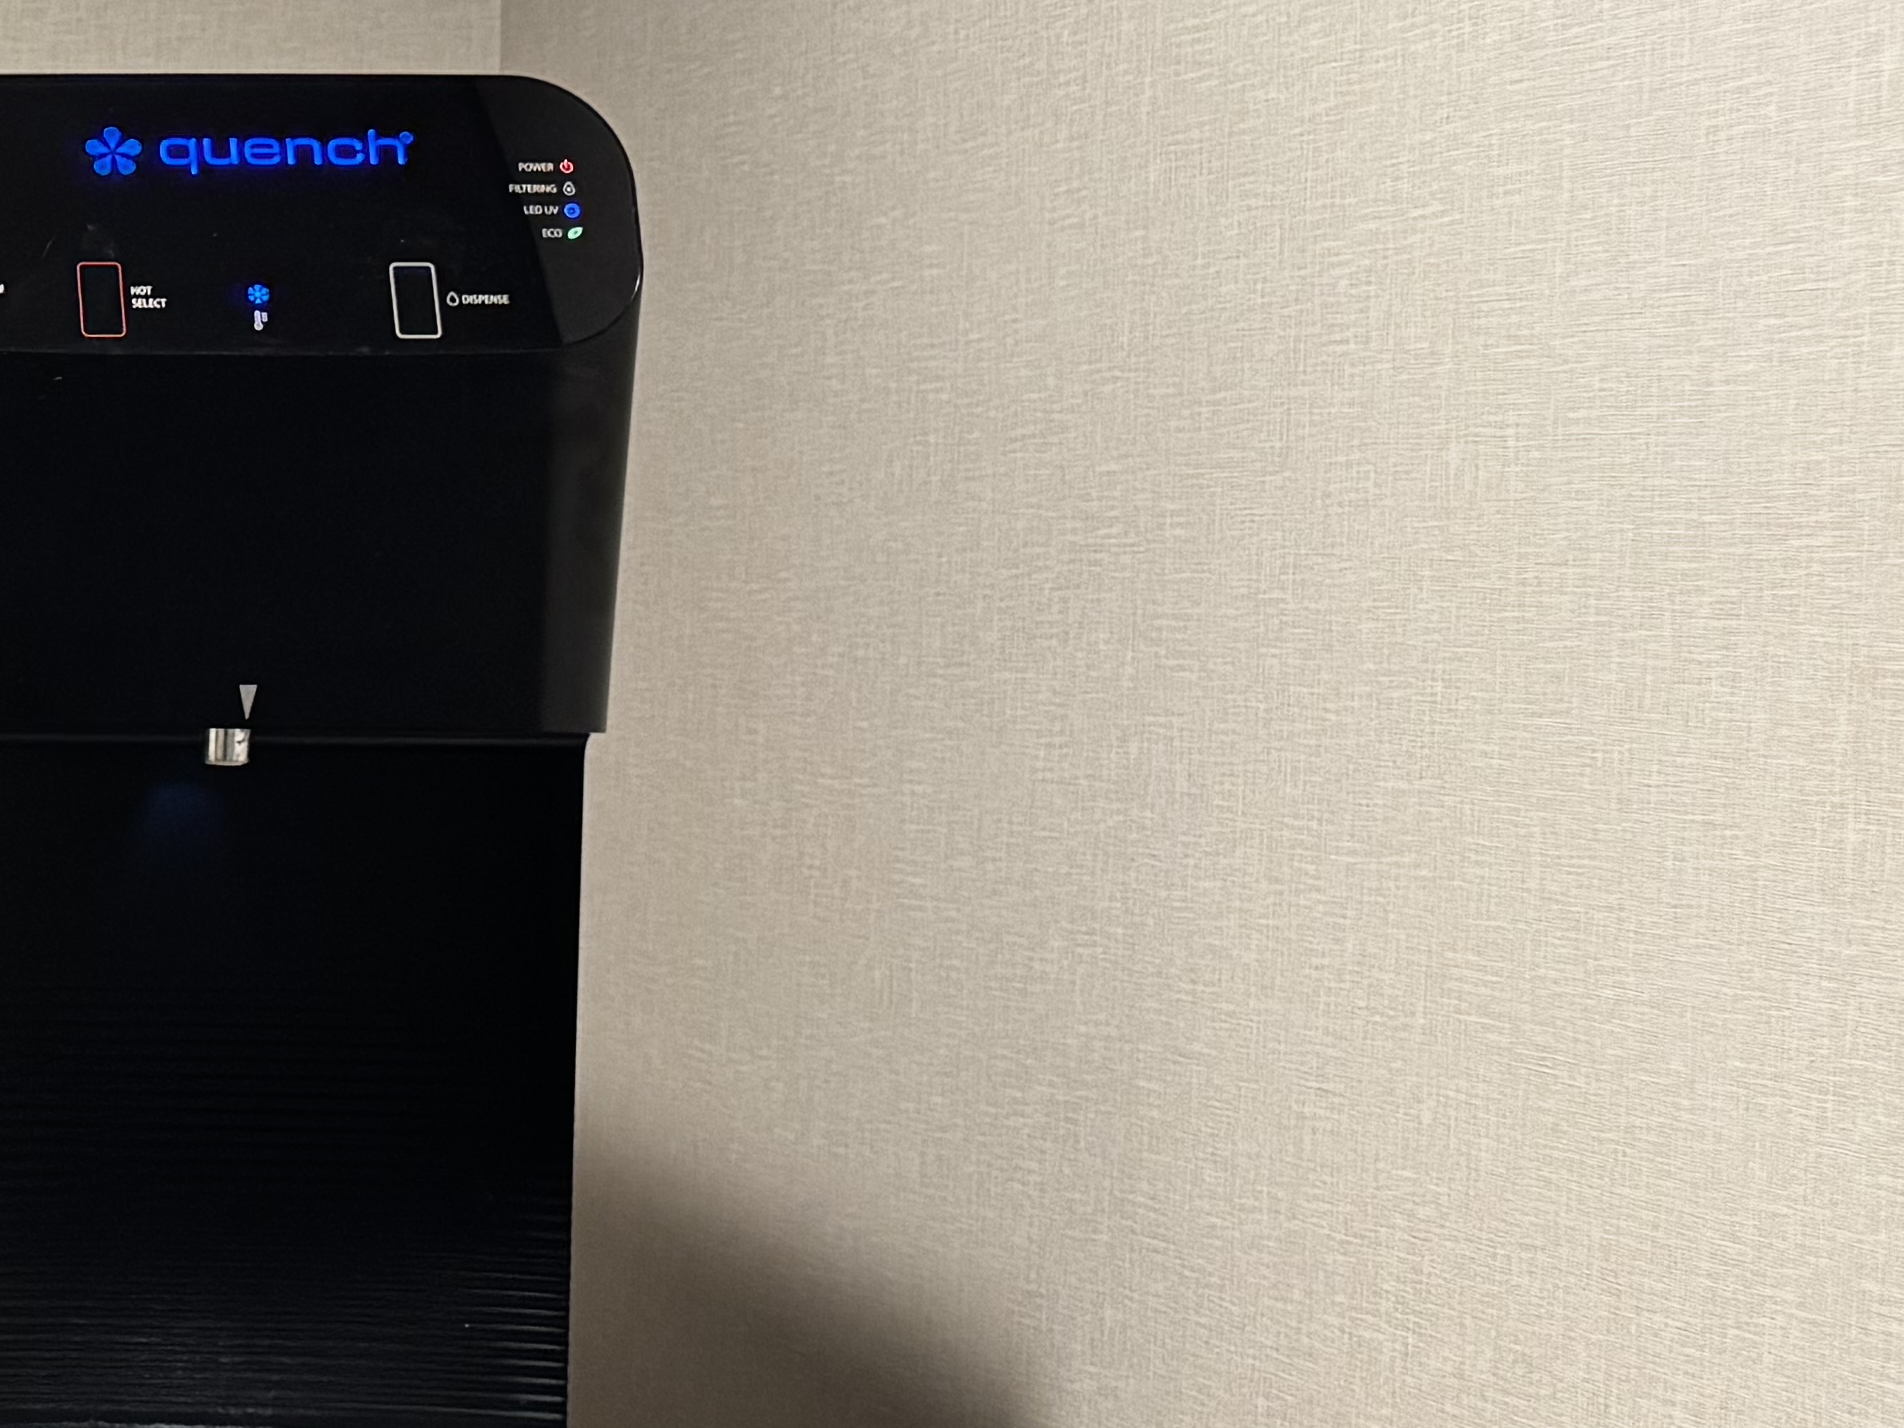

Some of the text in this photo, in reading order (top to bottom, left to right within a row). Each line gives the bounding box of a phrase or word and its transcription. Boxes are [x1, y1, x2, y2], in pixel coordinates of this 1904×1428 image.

[159, 128, 408, 175] quench
[518, 162, 554, 172] POWER
[508, 183, 558, 194] FILTERING
[523, 204, 559, 215] LED UV
[541, 228, 563, 238] ECO
[130, 285, 153, 296] HOT
[131, 297, 168, 309] SELECT
[461, 294, 510, 305] DISPENSE
